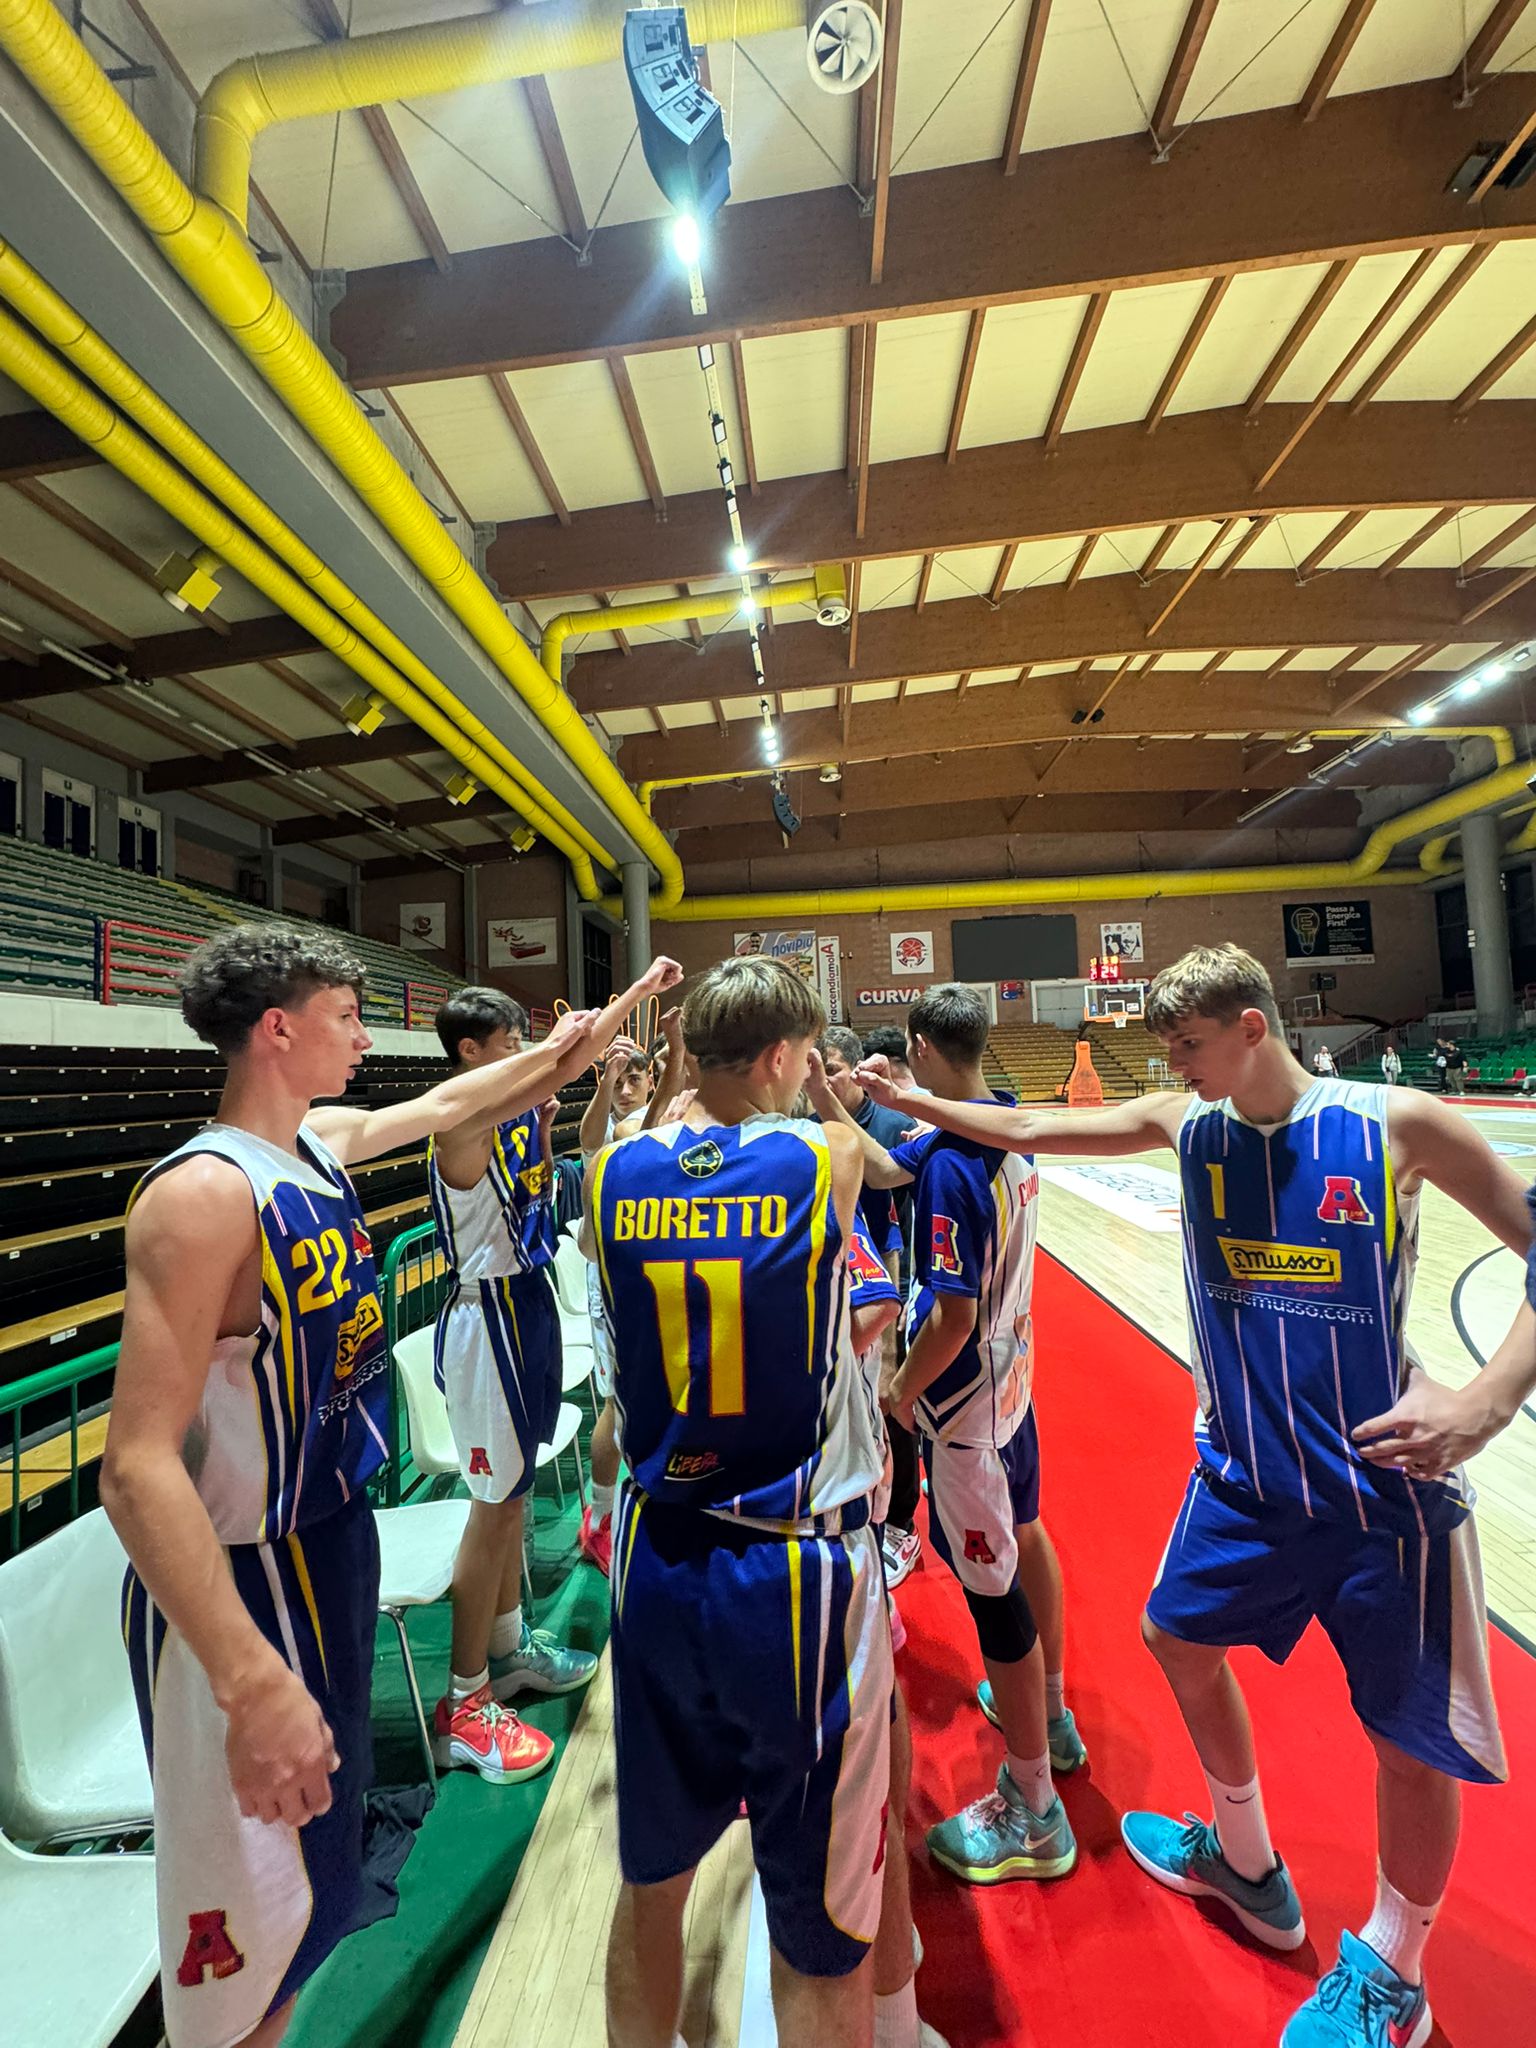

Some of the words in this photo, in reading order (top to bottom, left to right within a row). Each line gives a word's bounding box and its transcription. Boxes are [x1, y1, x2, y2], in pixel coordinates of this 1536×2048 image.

[1326, 912, 1361, 920] Energica
[1101, 966, 1118, 979] 24
[859, 988, 921, 1005] CURVA
[1205, 1163, 1226, 1219] 1
[1317, 1176, 1375, 1226] A
[614, 1194, 787, 1241] BORETTO
[290, 1227, 352, 1315] 22
[863, 1266, 881, 1279] pro
[1203, 1285, 1374, 1324] verdemusso.com
[642, 1259, 747, 1417] 11
[176, 1907, 245, 1988] A
